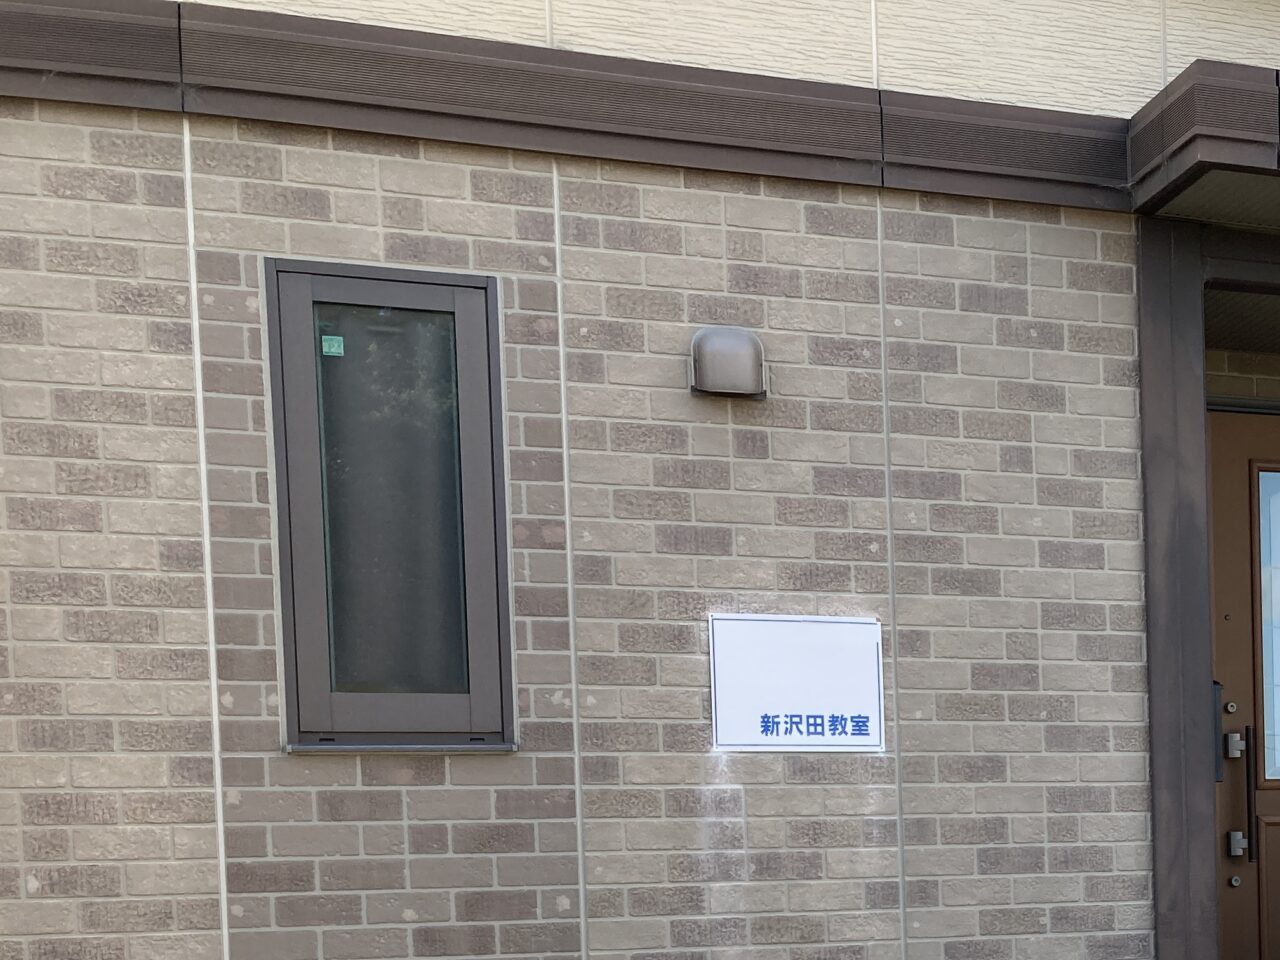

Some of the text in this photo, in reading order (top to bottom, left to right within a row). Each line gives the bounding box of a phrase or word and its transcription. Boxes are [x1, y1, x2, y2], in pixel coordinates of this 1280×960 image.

[760, 713, 870, 737] 新沢田教室
